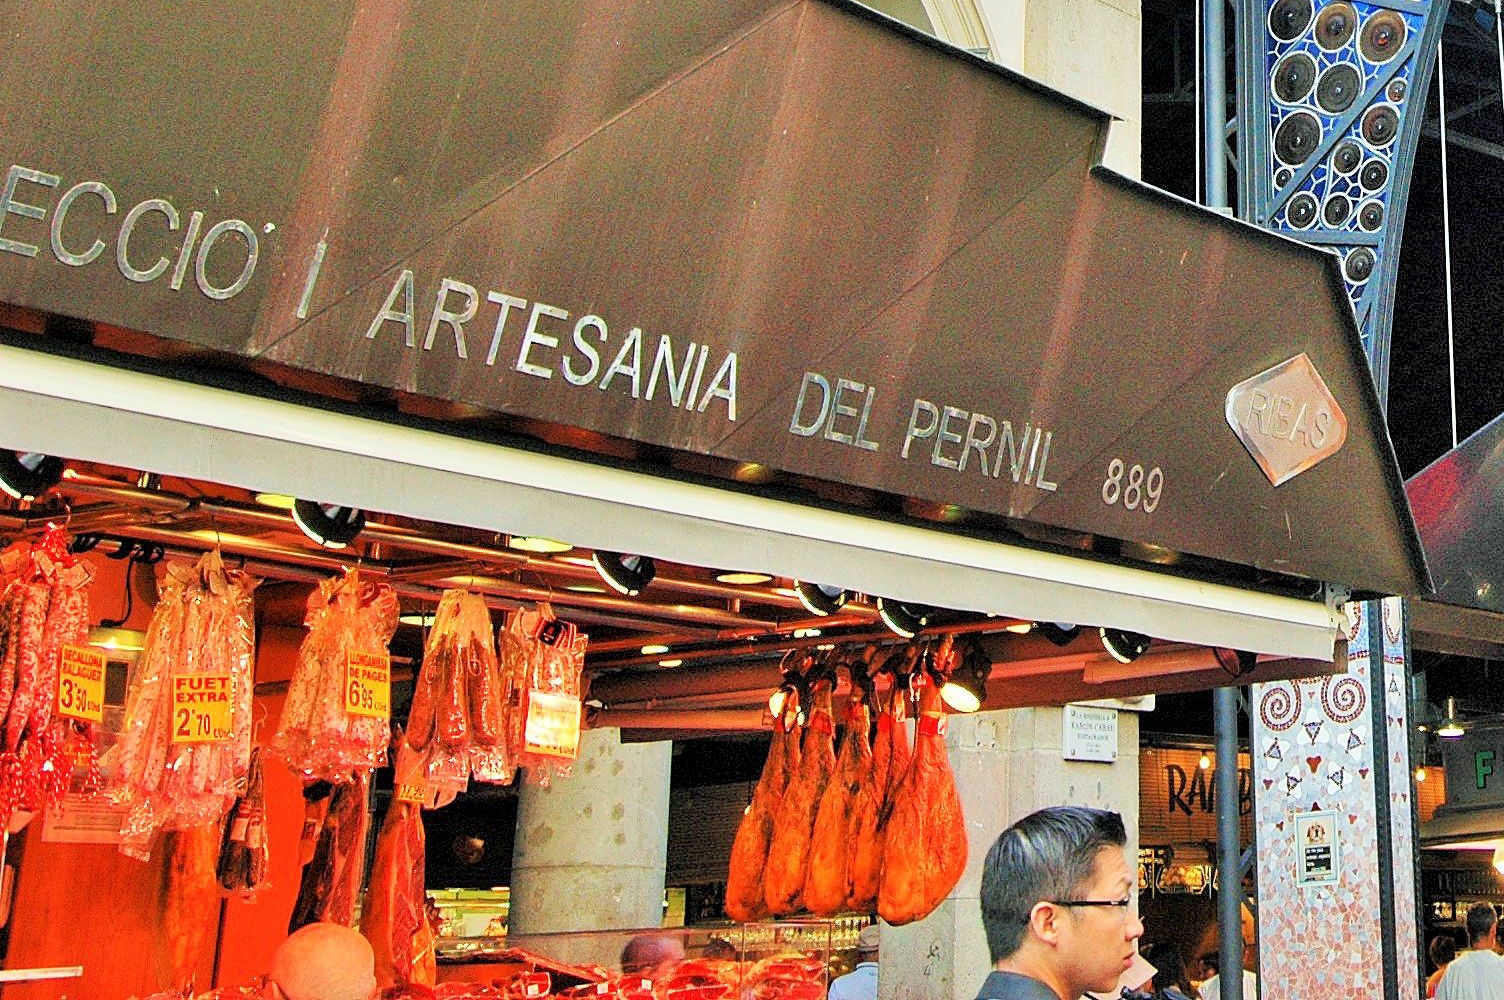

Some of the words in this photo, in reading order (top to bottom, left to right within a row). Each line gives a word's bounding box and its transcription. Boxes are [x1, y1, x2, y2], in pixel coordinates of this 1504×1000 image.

[365, 269, 738, 422] ARTESANIA
[789, 372, 879, 452] DEL
[901, 397, 1057, 492] PERNIL
[1244, 388, 1332, 449] RIBAS
[1102, 458, 1164, 513] 889
[176, 677, 229, 690] FUET
[349, 667, 360, 679] DE
[176, 691, 228, 703] EXTRA
